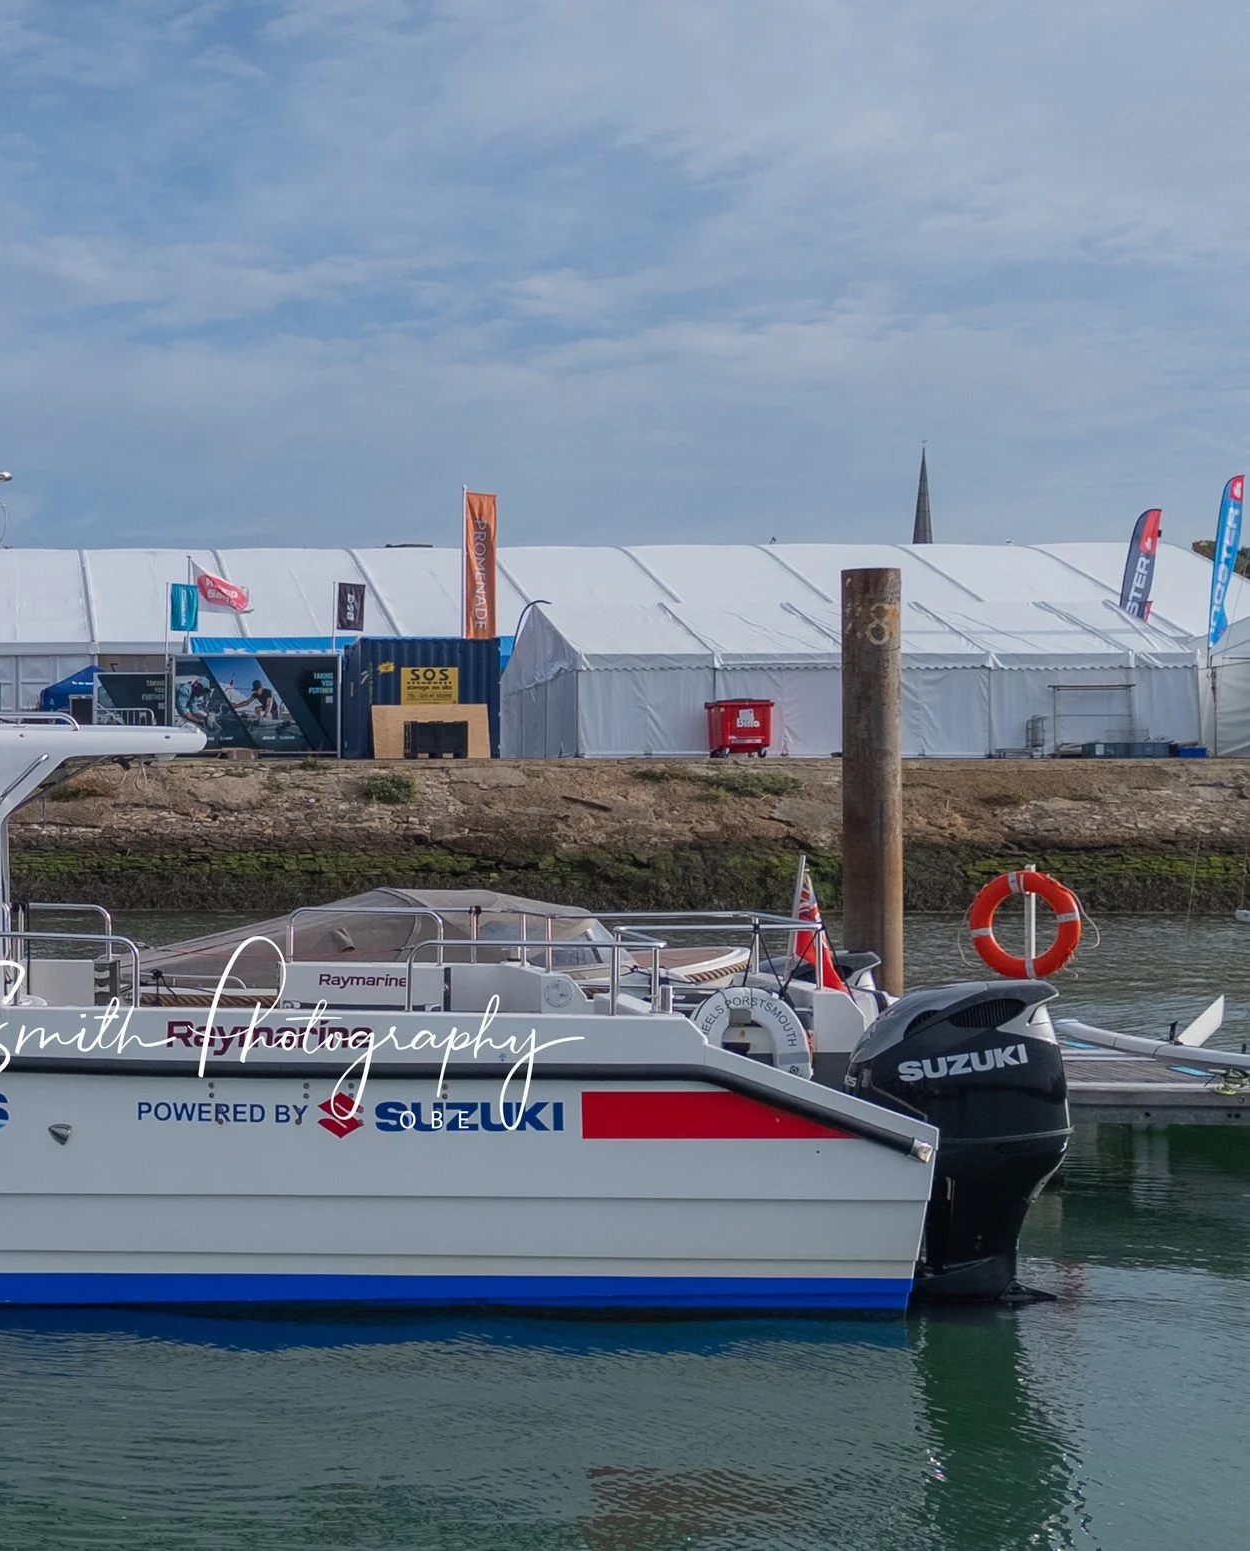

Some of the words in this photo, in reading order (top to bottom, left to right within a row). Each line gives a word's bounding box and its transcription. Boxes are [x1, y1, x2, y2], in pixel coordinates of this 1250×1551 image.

[473, 518, 488, 630] PROMENADE
[410, 668, 449, 681] SOS
[318, 972, 408, 989] Raymarine
[897, 1043, 1029, 1083] SUZUKI
[137, 1101, 266, 1123] POWERED
[275, 1103, 309, 1124] BY
[374, 1101, 565, 1134] SUZUKI
